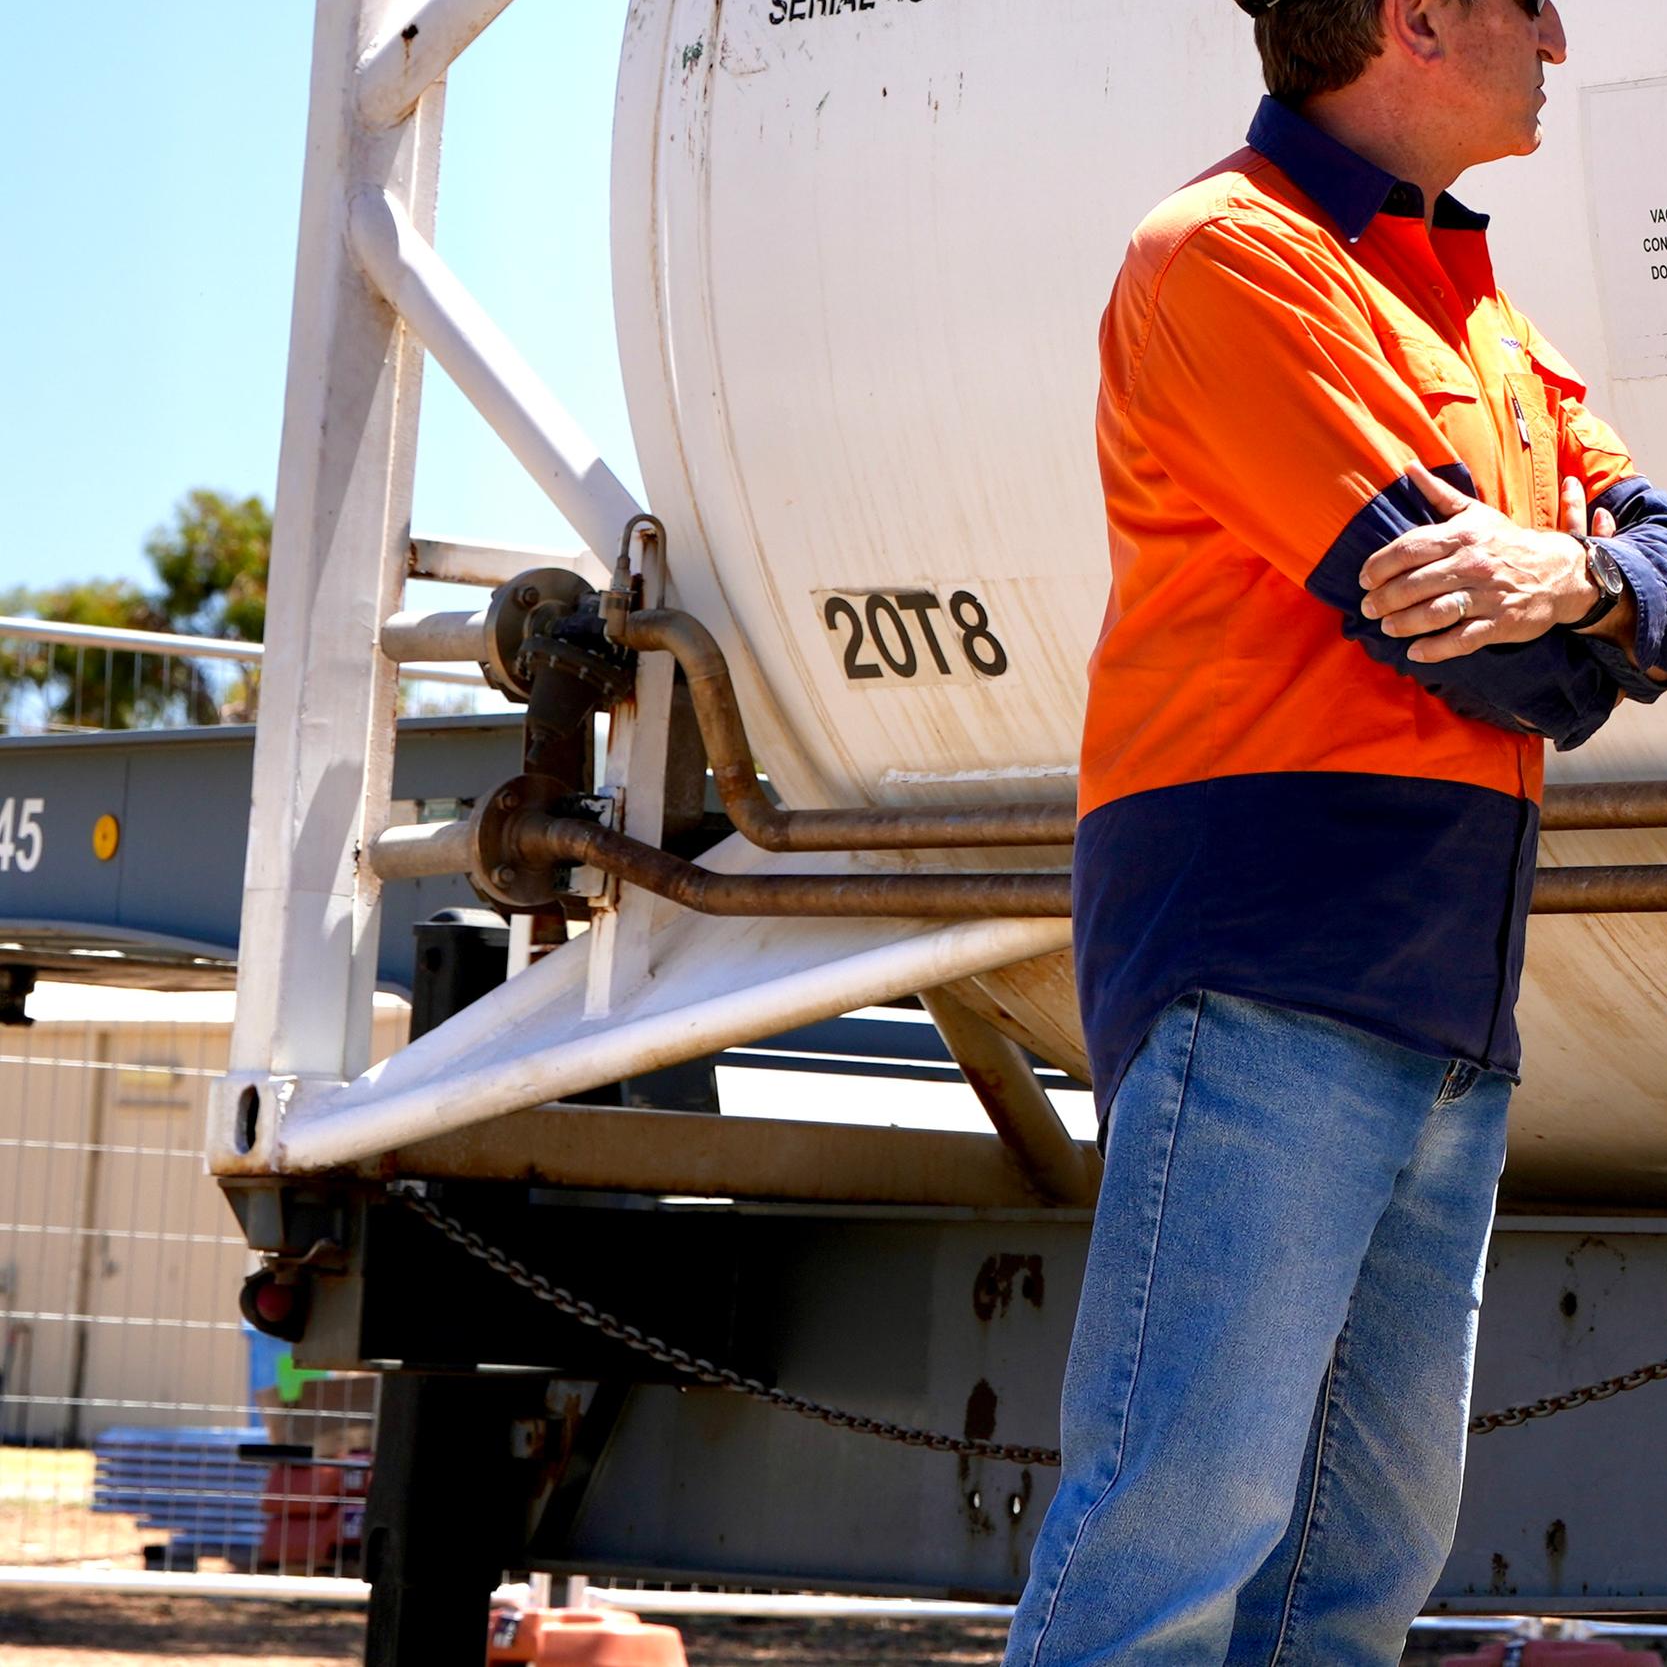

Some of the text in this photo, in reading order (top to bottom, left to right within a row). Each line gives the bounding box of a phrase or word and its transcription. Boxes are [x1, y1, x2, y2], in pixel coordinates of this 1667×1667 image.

[1651, 265, 1667, 280] DO
[824, 591, 1007, 679] 20T8
[0, 797, 43, 872] 45
